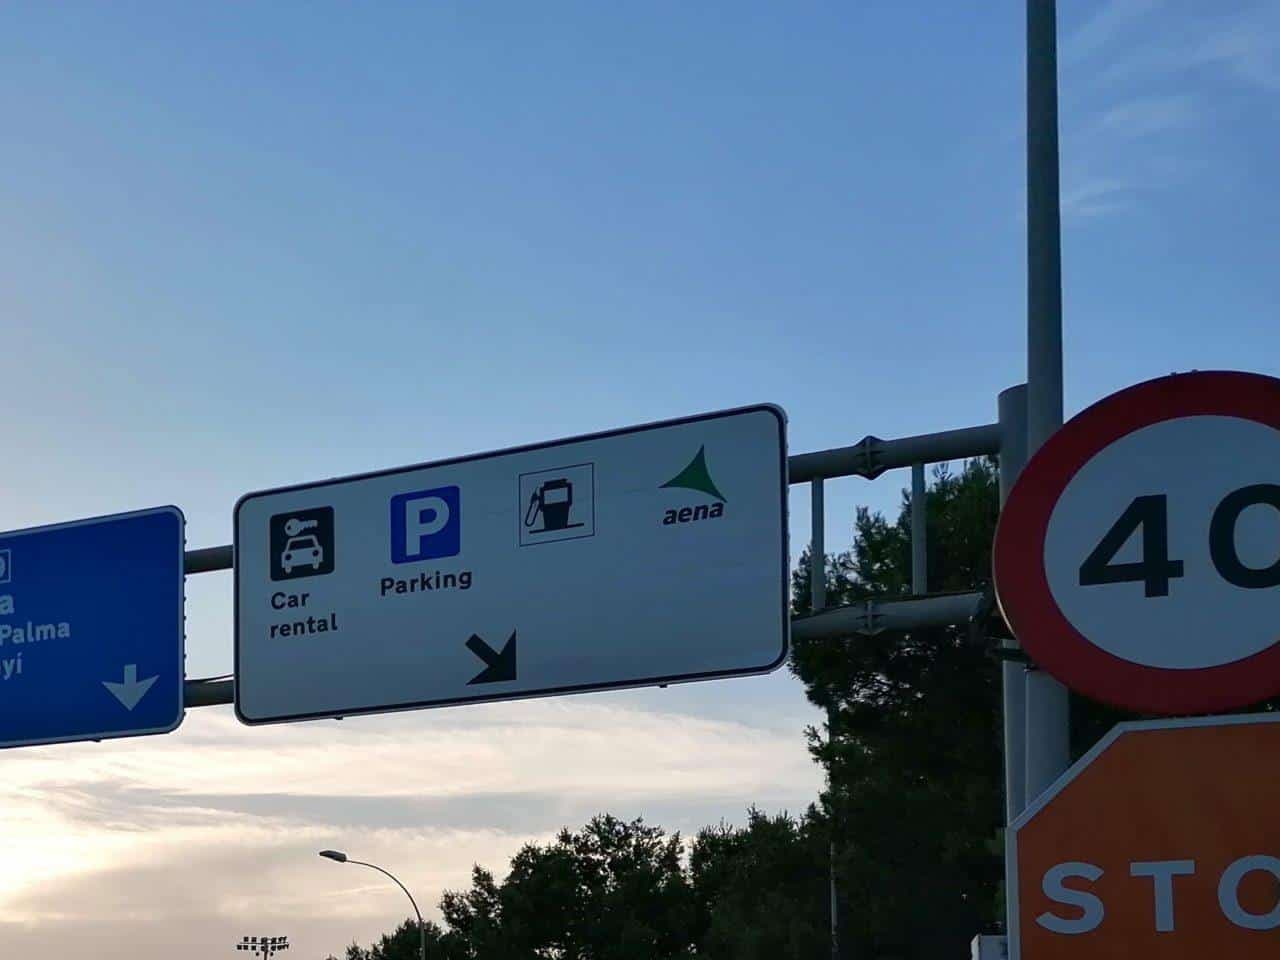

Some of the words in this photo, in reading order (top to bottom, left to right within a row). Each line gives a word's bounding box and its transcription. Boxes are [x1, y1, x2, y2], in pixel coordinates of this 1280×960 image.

[406, 495, 450, 555] P
[662, 501, 724, 525] aena
[1078, 483, 1280, 598] 40
[381, 568, 472, 596] Parking
[271, 590, 310, 610] Car
[269, 612, 338, 639] rental
